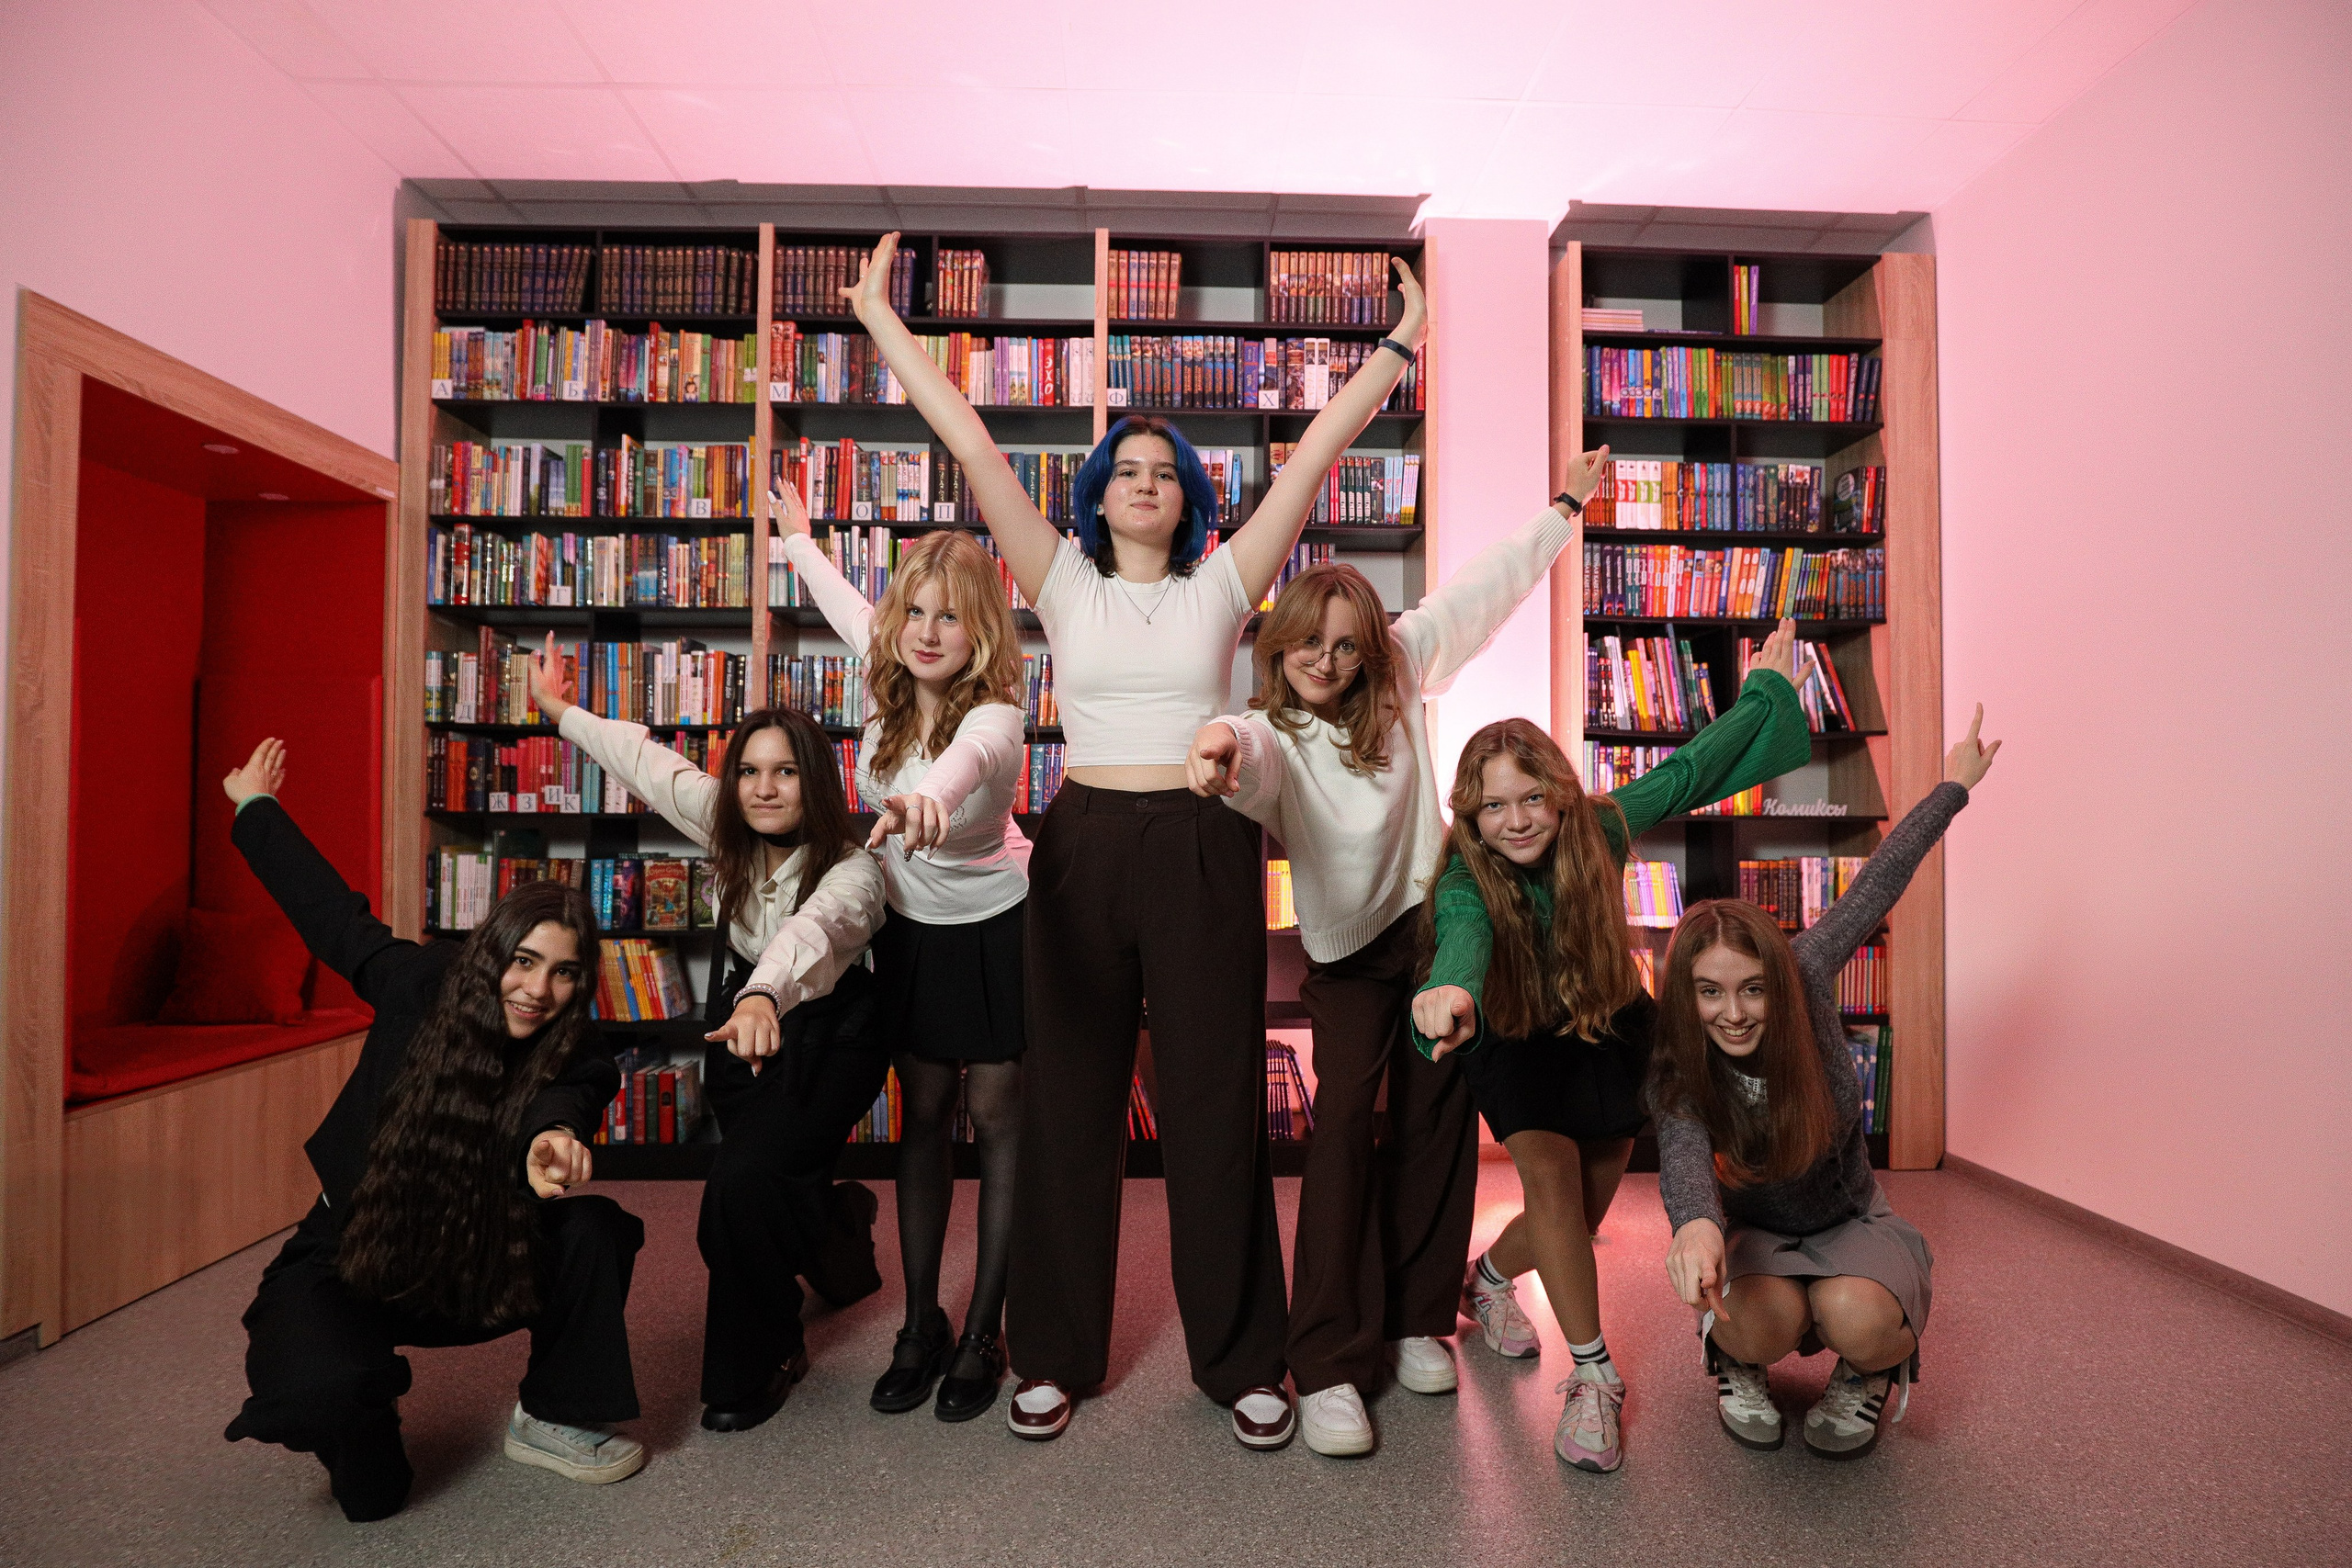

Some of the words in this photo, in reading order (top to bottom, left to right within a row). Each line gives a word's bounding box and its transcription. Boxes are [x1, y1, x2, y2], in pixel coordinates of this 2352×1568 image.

[435, 381, 449, 396] А
[568, 382, 579, 397] Б
[772, 385, 787, 399] М
[1109, 391, 1125, 405] Ф
[1262, 392, 1275, 406] Х
[695, 501, 707, 515] В
[855, 504, 869, 518] О
[938, 504, 952, 519] П
[555, 588, 567, 604] Г
[458, 705, 473, 721] Д
[492, 795, 506, 809] Ж
[548, 787, 561, 802] И
[523, 795, 532, 810] З
[564, 796, 576, 810] К
[1762, 798, 1848, 817] Комиксы
